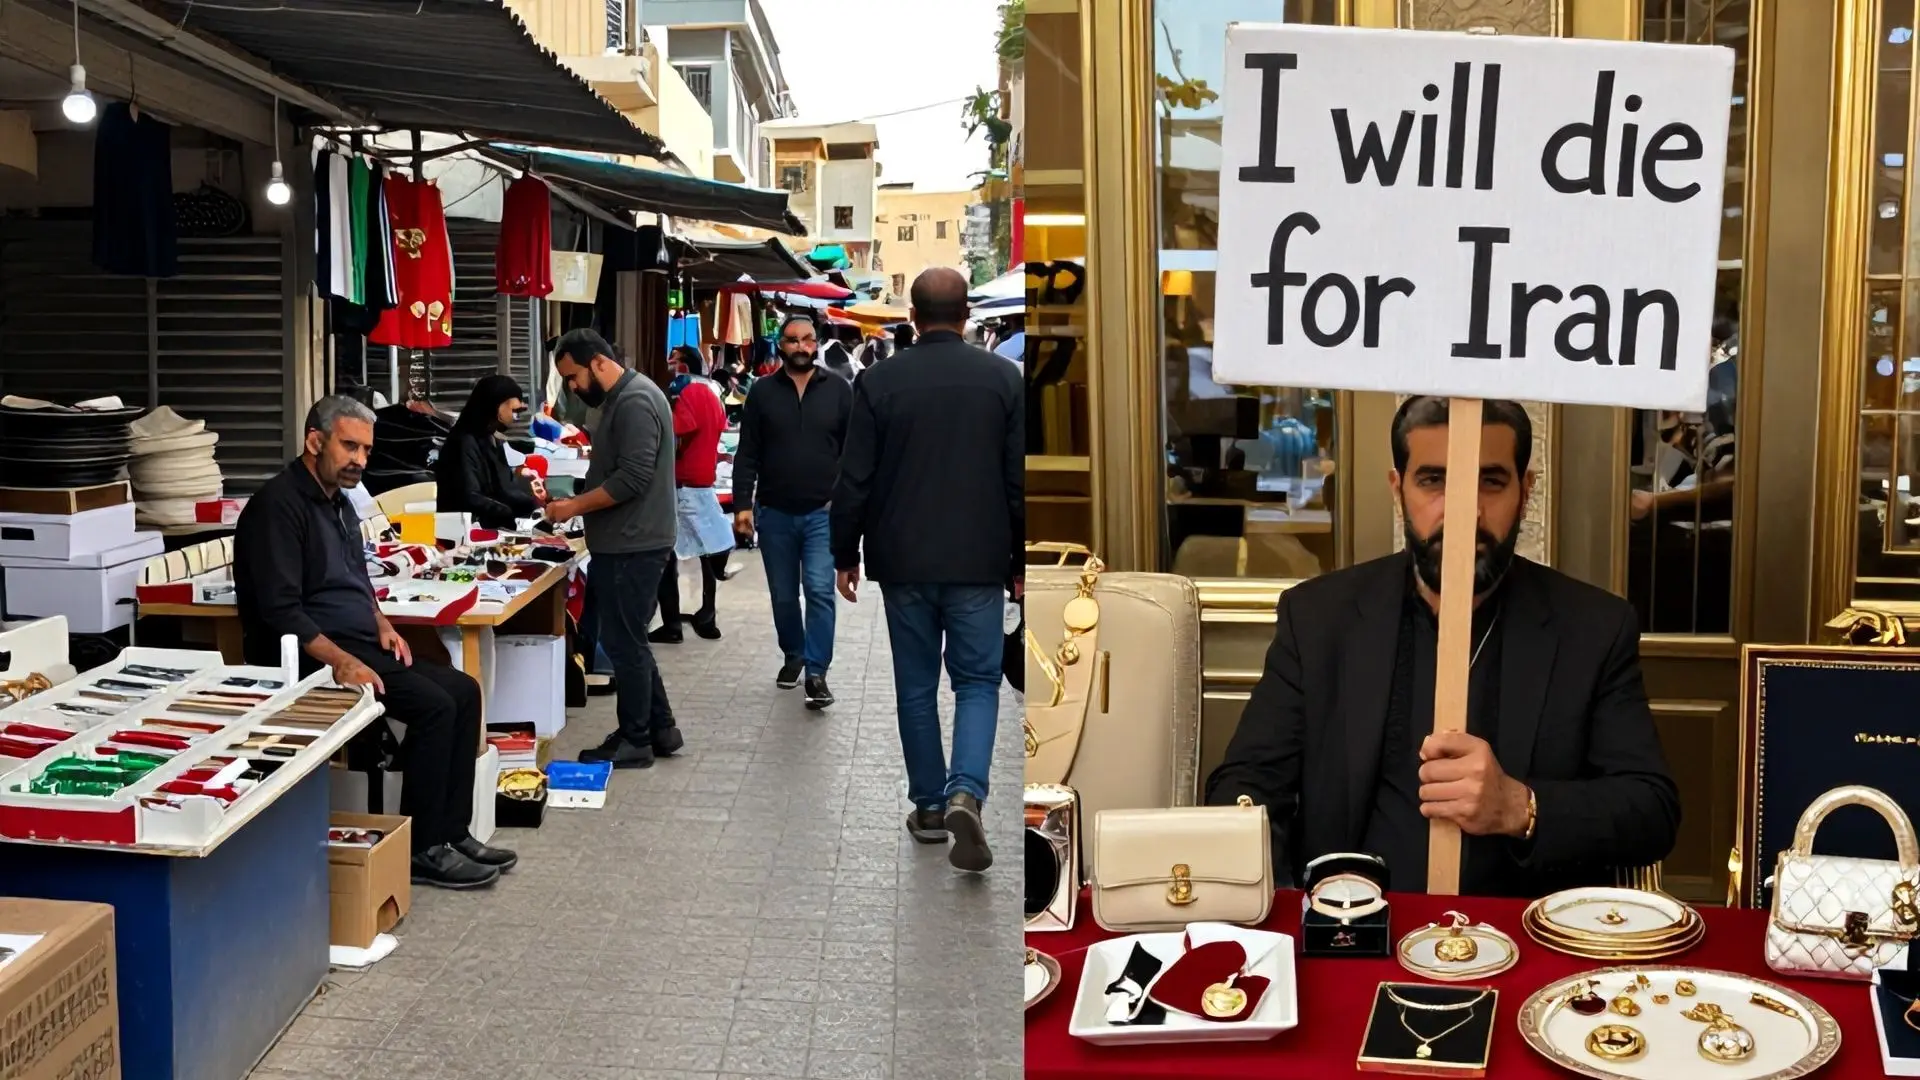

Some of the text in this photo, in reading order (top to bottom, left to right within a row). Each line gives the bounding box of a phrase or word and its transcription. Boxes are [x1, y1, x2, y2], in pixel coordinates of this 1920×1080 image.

[1239, 52, 1704, 203] I will die
[1250, 211, 1680, 371] for Iran
